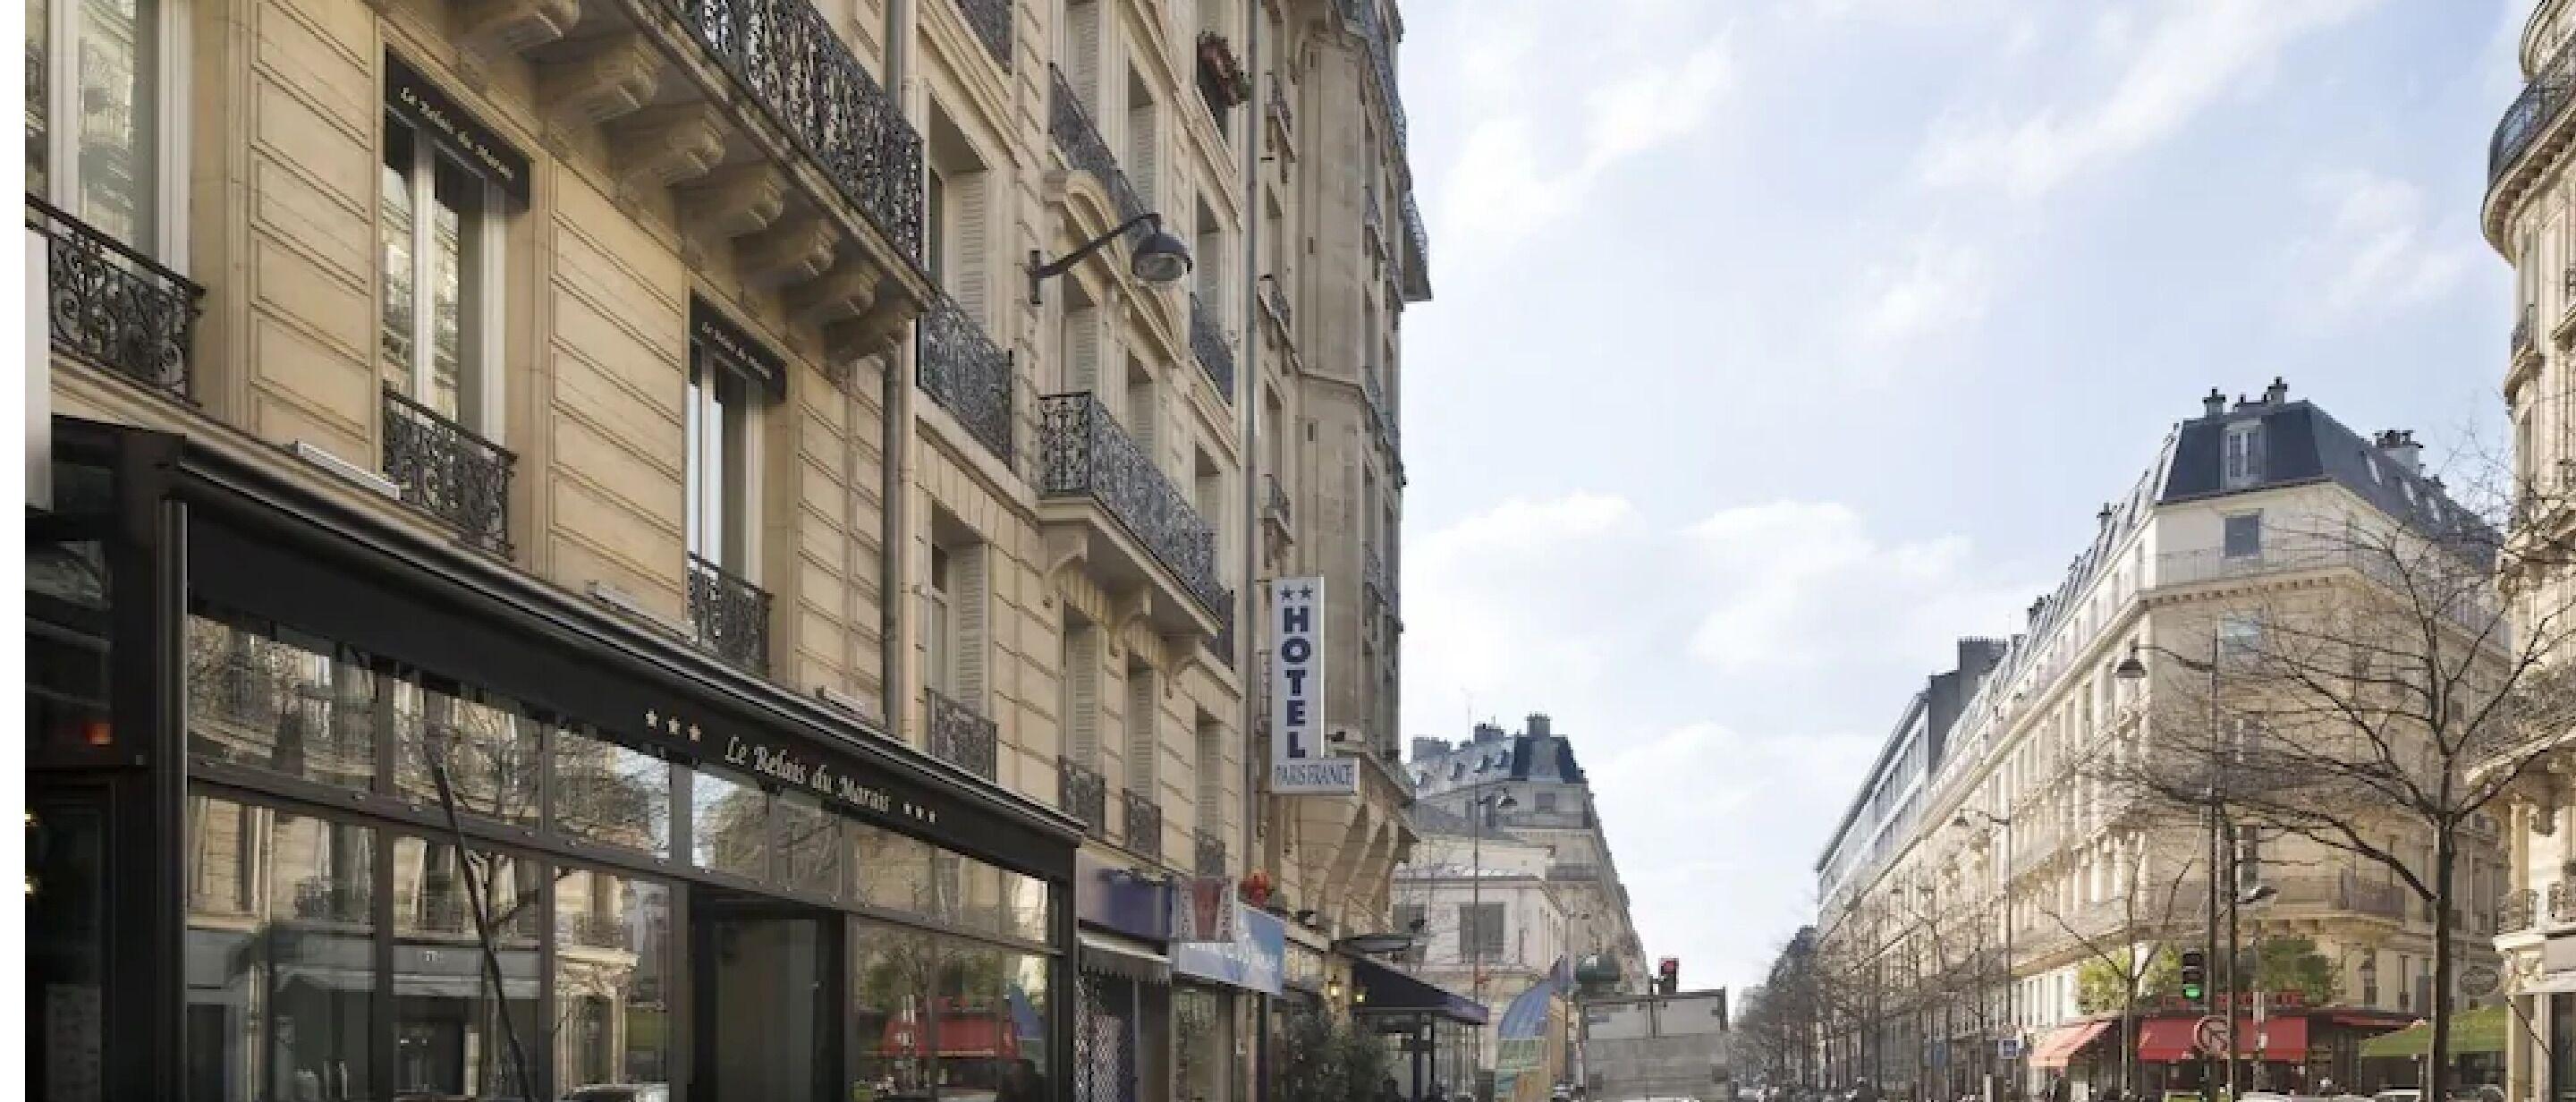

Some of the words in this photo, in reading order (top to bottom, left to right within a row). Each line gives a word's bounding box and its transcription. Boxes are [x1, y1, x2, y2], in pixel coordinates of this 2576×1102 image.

[1281, 606, 1312, 759] HOTEL
[724, 735, 748, 766] Le
[752, 746, 806, 784] Relais
[811, 764, 834, 794] du
[837, 774, 892, 814] Marais
[1274, 764, 1306, 786] PARIS
[1307, 764, 1353, 786] FRANCE
